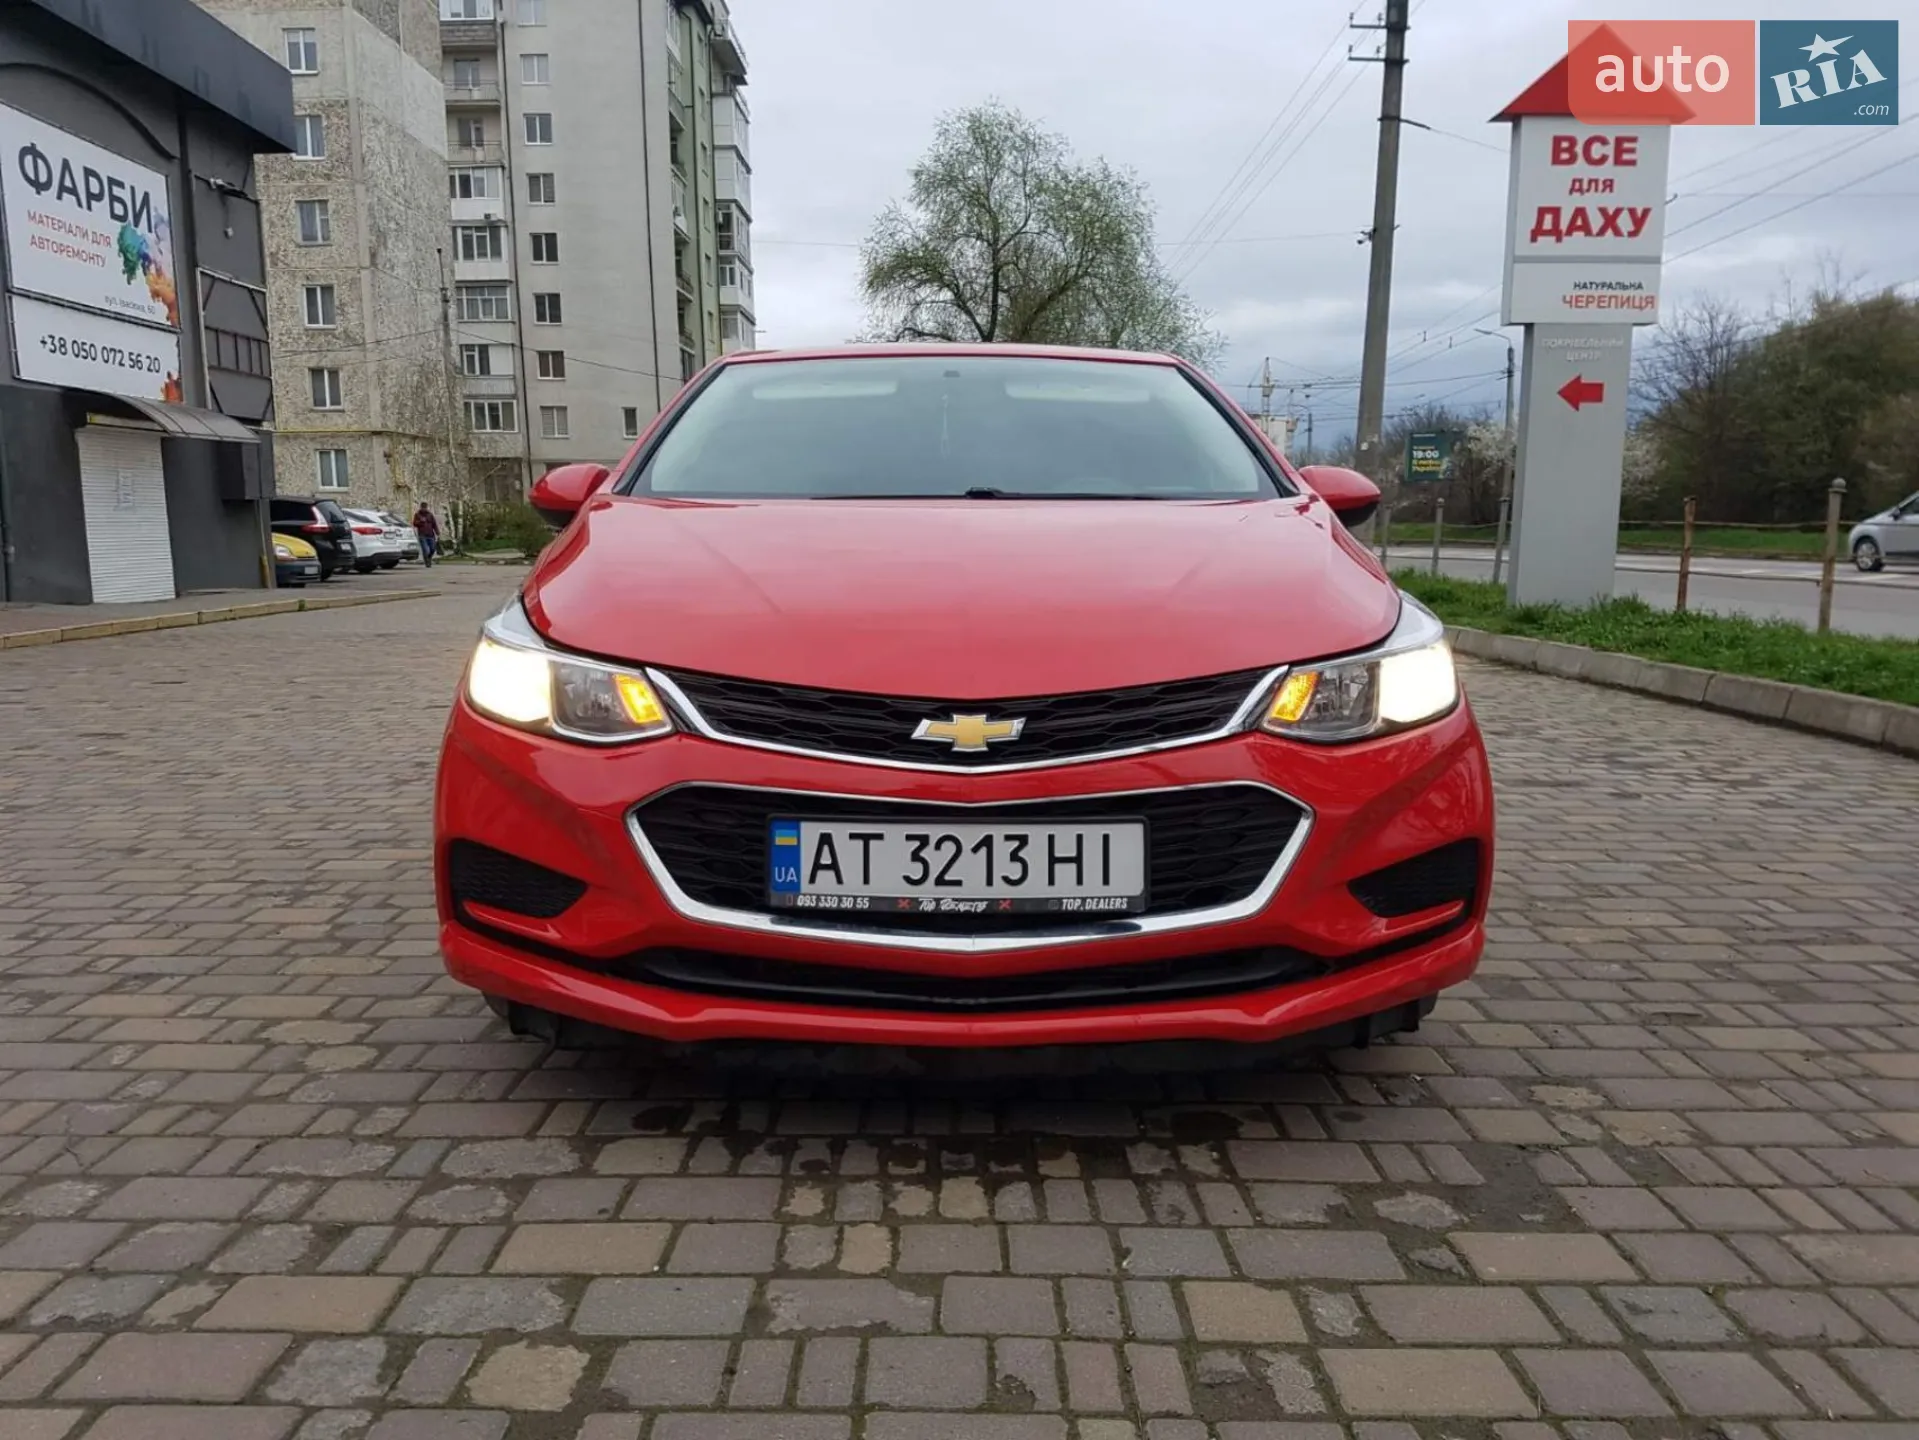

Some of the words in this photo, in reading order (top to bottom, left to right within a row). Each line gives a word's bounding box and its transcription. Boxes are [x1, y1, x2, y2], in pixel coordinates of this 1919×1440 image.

[1550, 135, 1638, 167] ВСЕ
[18, 142, 153, 233] ФАРБИ
[27, 209, 90, 241] МАТЕРІАЛИ
[91, 229, 112, 249] ДЛЯ
[1530, 206, 1651, 243] ДАХУ
[29, 233, 107, 268] АВТОРЕМОНТУ
[1562, 294, 1655, 311] ЧЕРЕПИЦЯ
[1573, 281, 1644, 291] НАТУРАЛЬНА
[39, 334, 68, 356] +38
[71, 339, 98, 362] 050
[100, 345, 126, 368] 072
[128, 350, 144, 371] 56
[146, 355, 161, 374] 20
[775, 867, 797, 883] UA
[808, 832, 884, 886] AT
[902, 833, 1029, 887] 3213
[1047, 833, 1110, 887] HI
[797, 895, 817, 907] 093
[818, 896, 838, 908] 330
[840, 897, 854, 908] 30
[856, 897, 870, 909] 55
